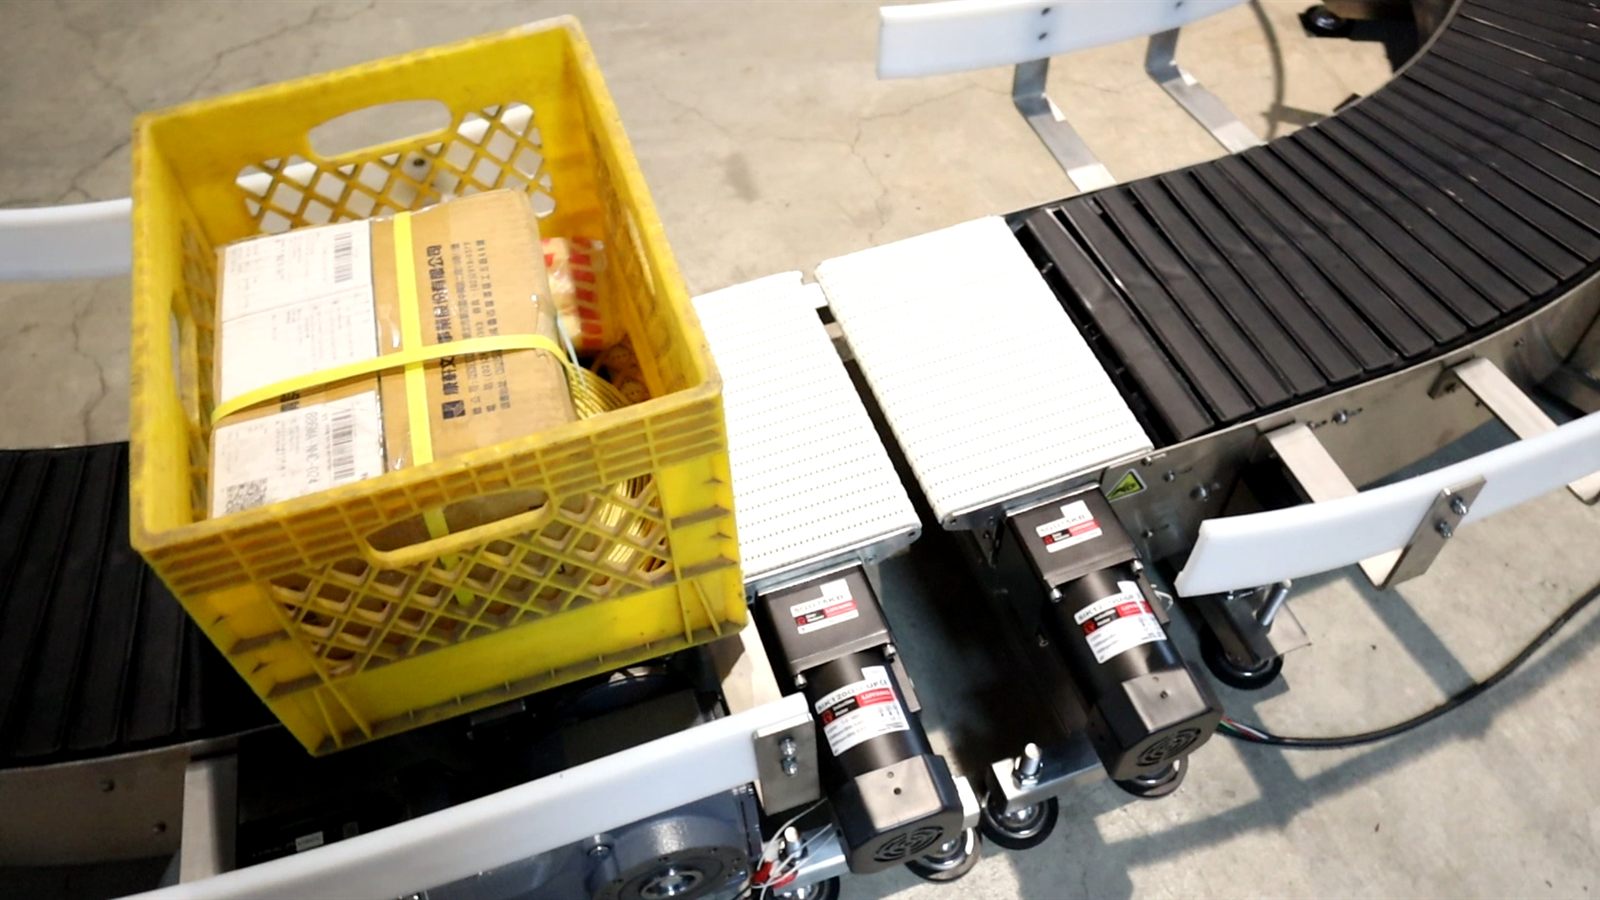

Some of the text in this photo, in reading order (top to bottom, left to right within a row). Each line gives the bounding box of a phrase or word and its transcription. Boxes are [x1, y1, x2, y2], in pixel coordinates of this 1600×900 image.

[426, 244, 458, 395] 康軒文事業股份有限公司
